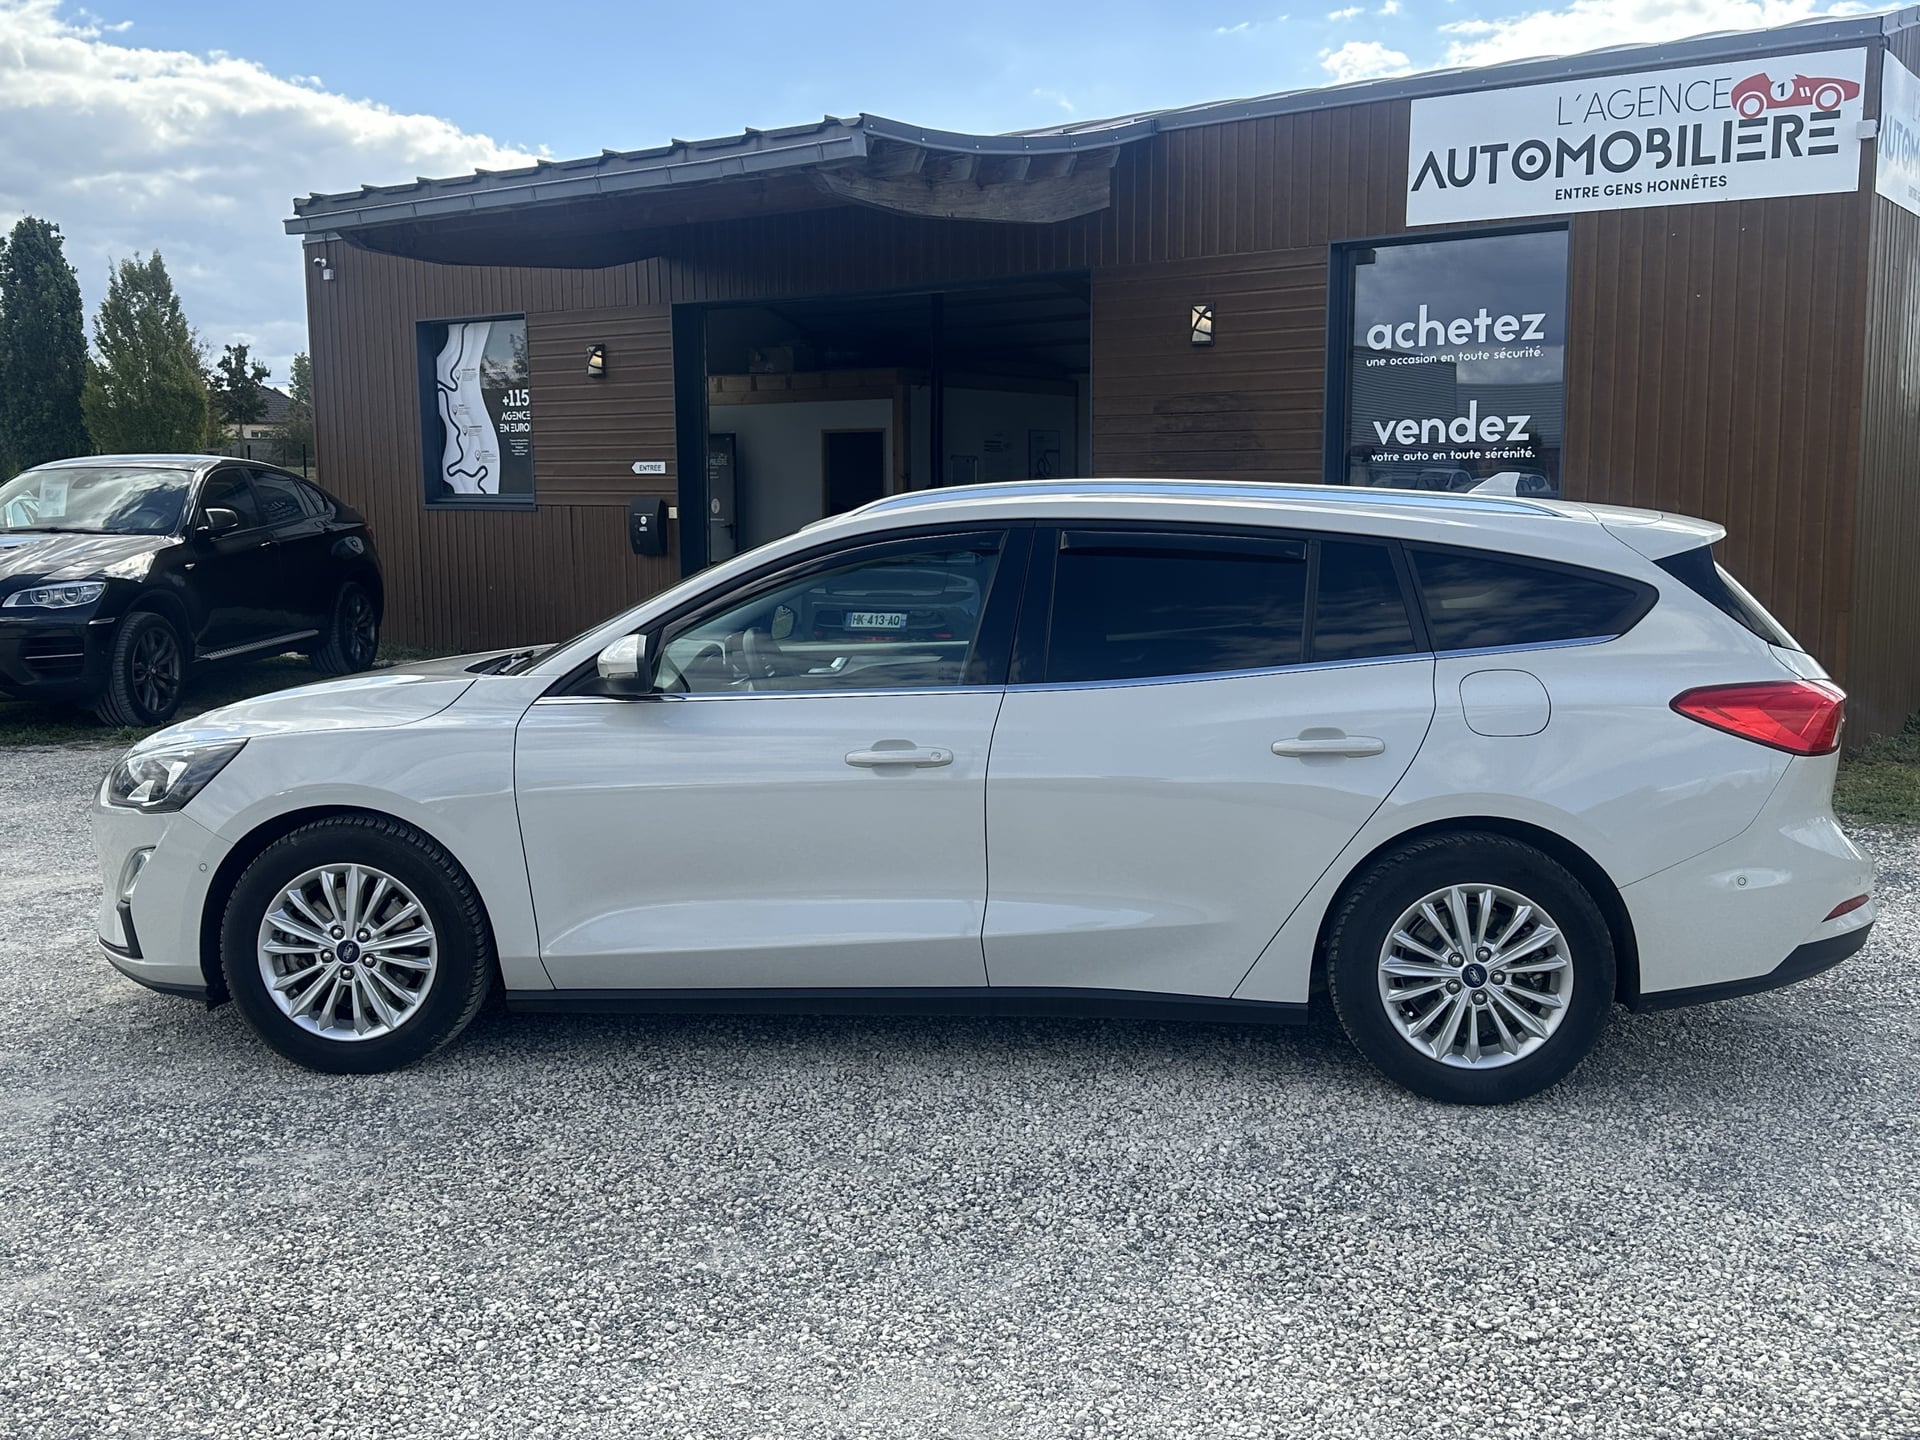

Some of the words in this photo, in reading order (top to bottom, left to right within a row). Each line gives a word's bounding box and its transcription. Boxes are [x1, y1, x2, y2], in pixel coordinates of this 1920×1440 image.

[1558, 78, 1732, 126] L'AGENCE
[1555, 186, 1600, 200] ENTRE
[1603, 182, 1643, 196] GENS
[1647, 174, 1727, 193] HONNÊTES
[1366, 304, 1546, 351] achetez
[1366, 357, 1386, 367] une
[1389, 353, 1437, 366] occasion
[1440, 353, 1455, 363] en
[1458, 350, 1490, 362] toute
[1493, 345, 1544, 359] sécurité.
[499, 423, 510, 432] EN
[1372, 400, 1531, 446] vendez
[1371, 451, 1399, 462] votre
[1402, 450, 1429, 462] auto
[1432, 450, 1446, 460] en
[1449, 448, 1481, 460] toute
[1484, 446, 1536, 459] sérénité.
